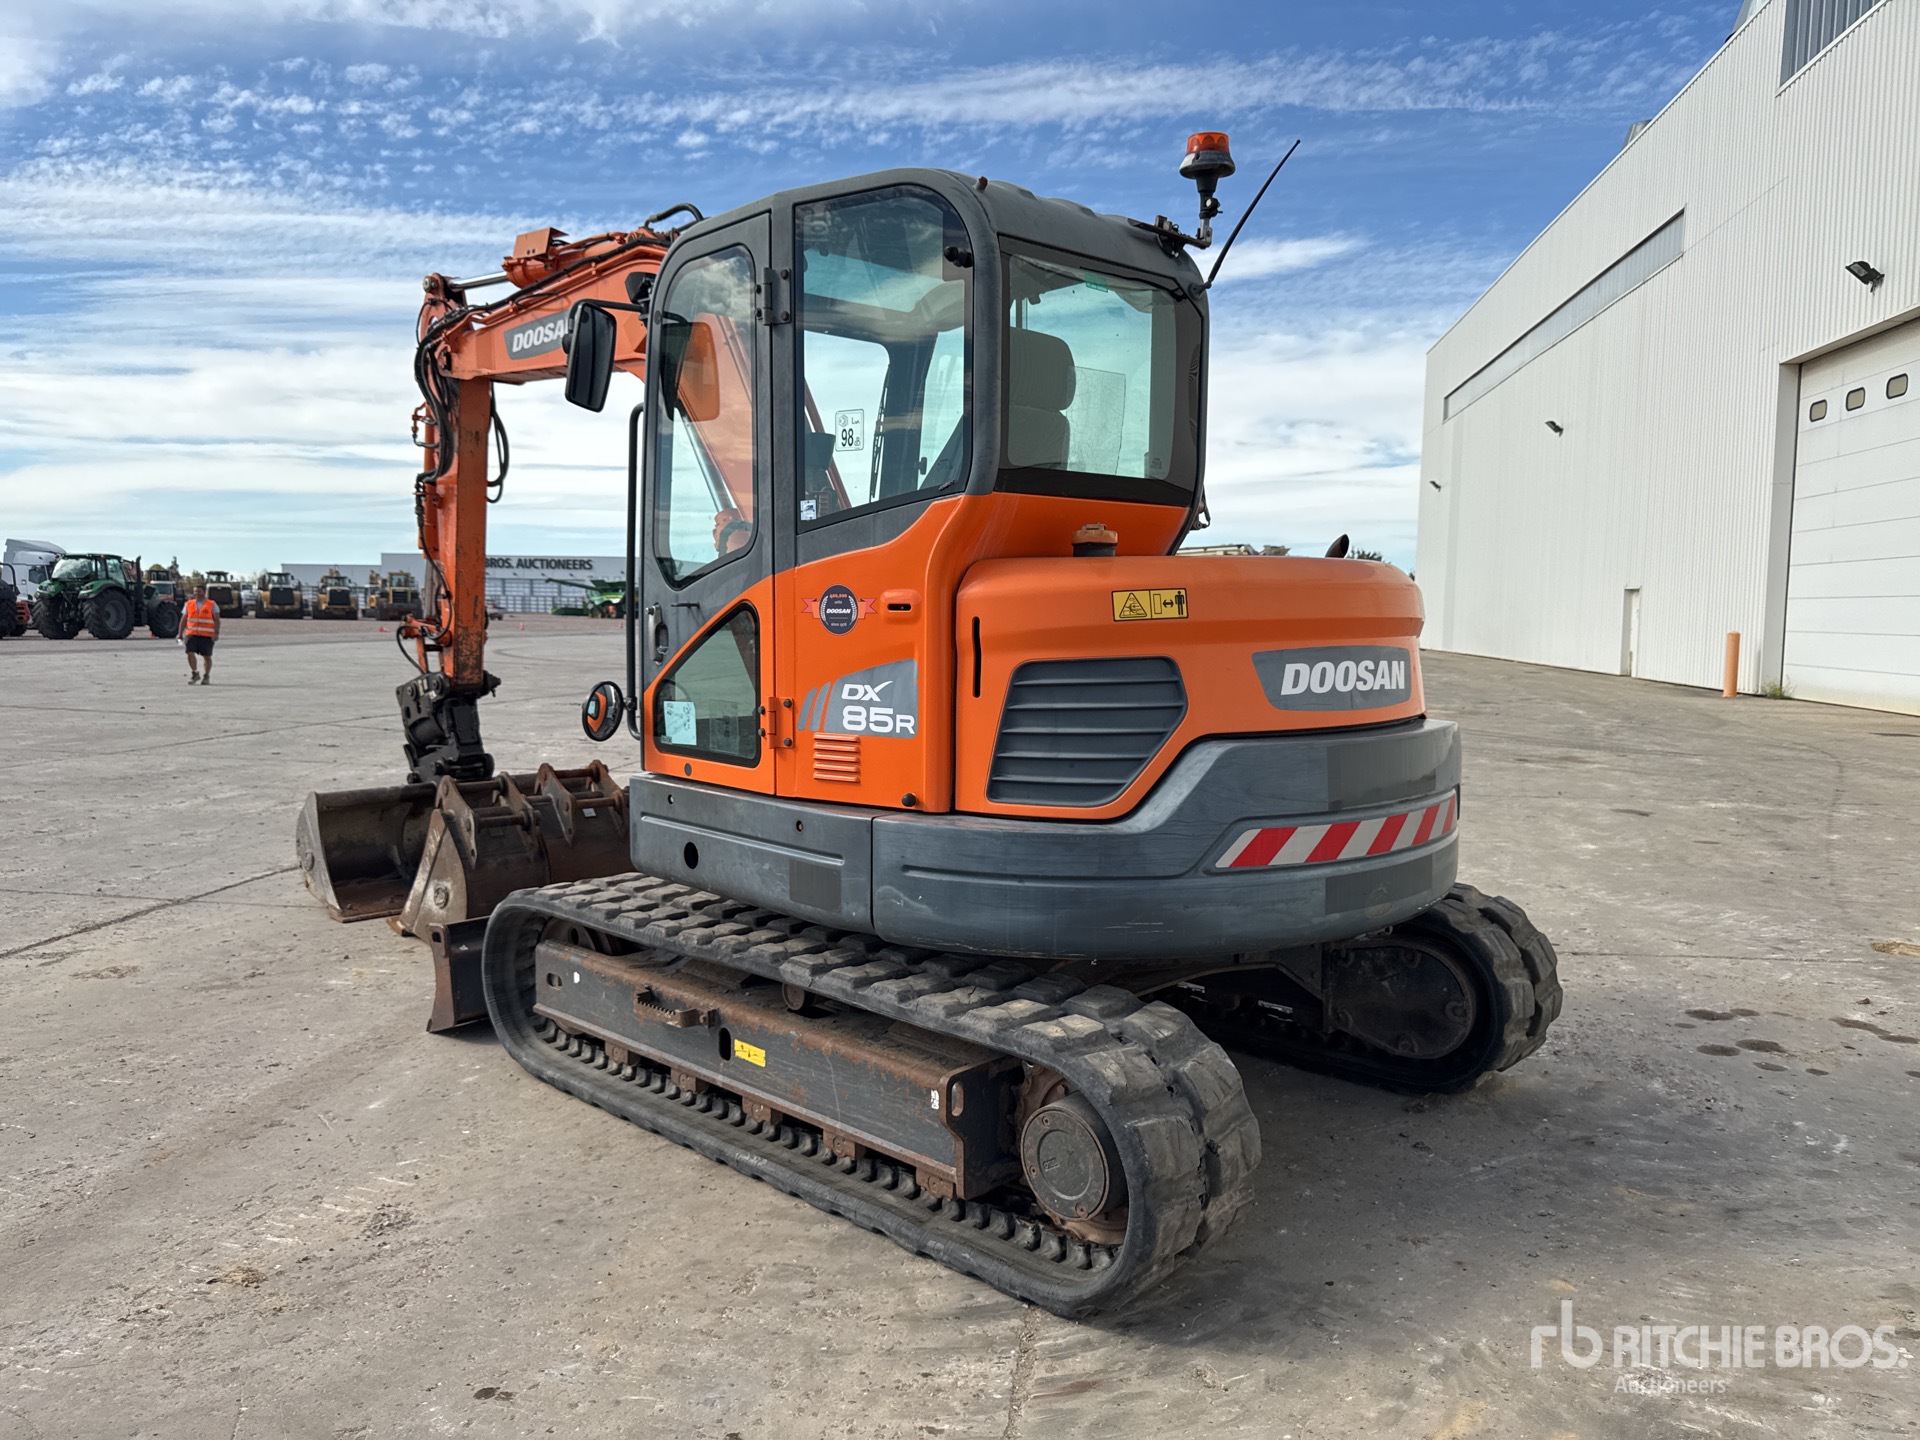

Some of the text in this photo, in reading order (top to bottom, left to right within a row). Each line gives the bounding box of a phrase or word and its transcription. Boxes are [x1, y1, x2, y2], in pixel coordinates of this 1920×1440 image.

[841, 428, 854, 447] 98
[516, 558, 593, 570] AUCTIONEERS
[1280, 659, 1405, 695] DOOSAN
[841, 680, 894, 702] DX
